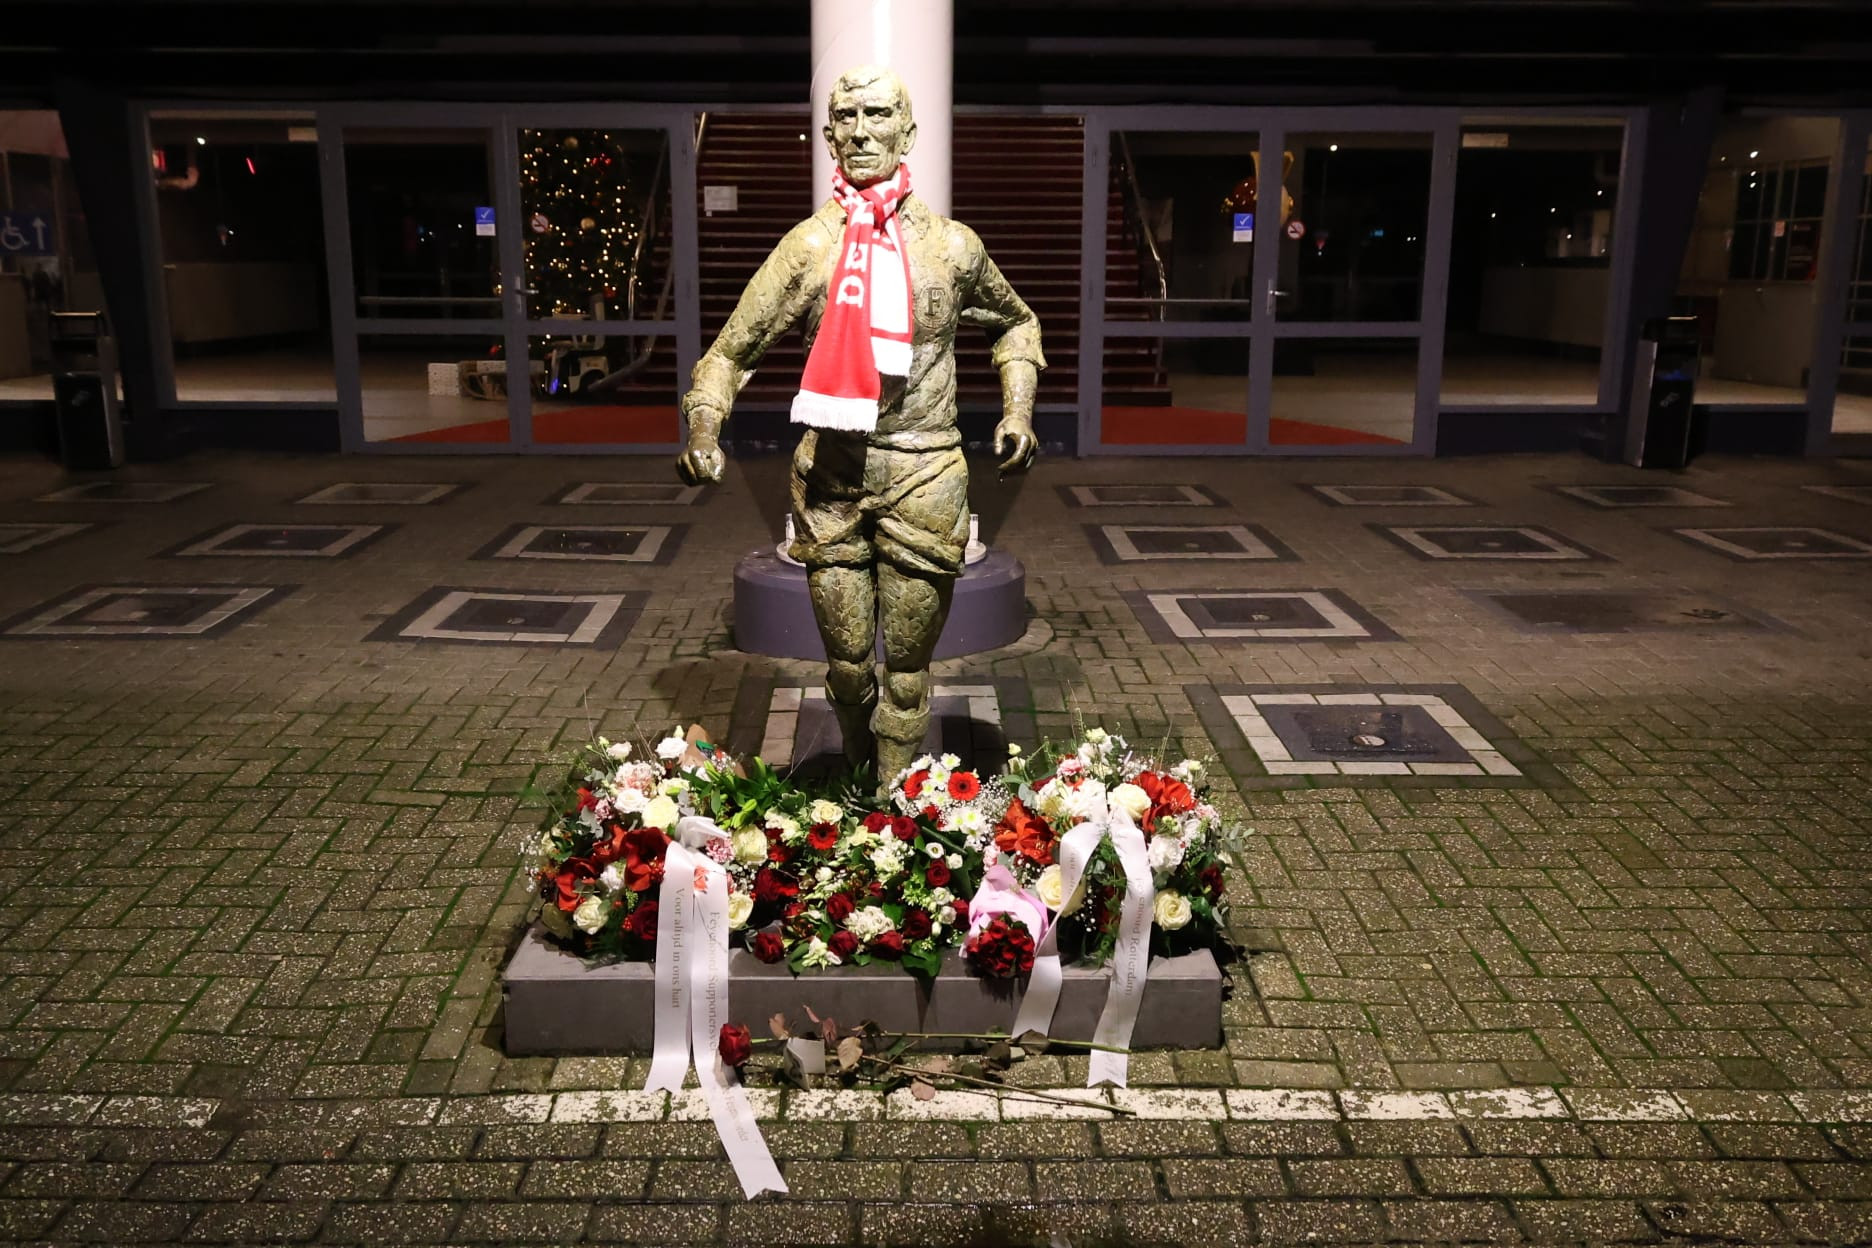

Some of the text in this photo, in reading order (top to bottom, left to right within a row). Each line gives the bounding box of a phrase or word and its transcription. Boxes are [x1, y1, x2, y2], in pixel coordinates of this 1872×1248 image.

[671, 887, 685, 1008] Voor altijd in ons hart
[1125, 937, 1141, 997] Rotterdam
